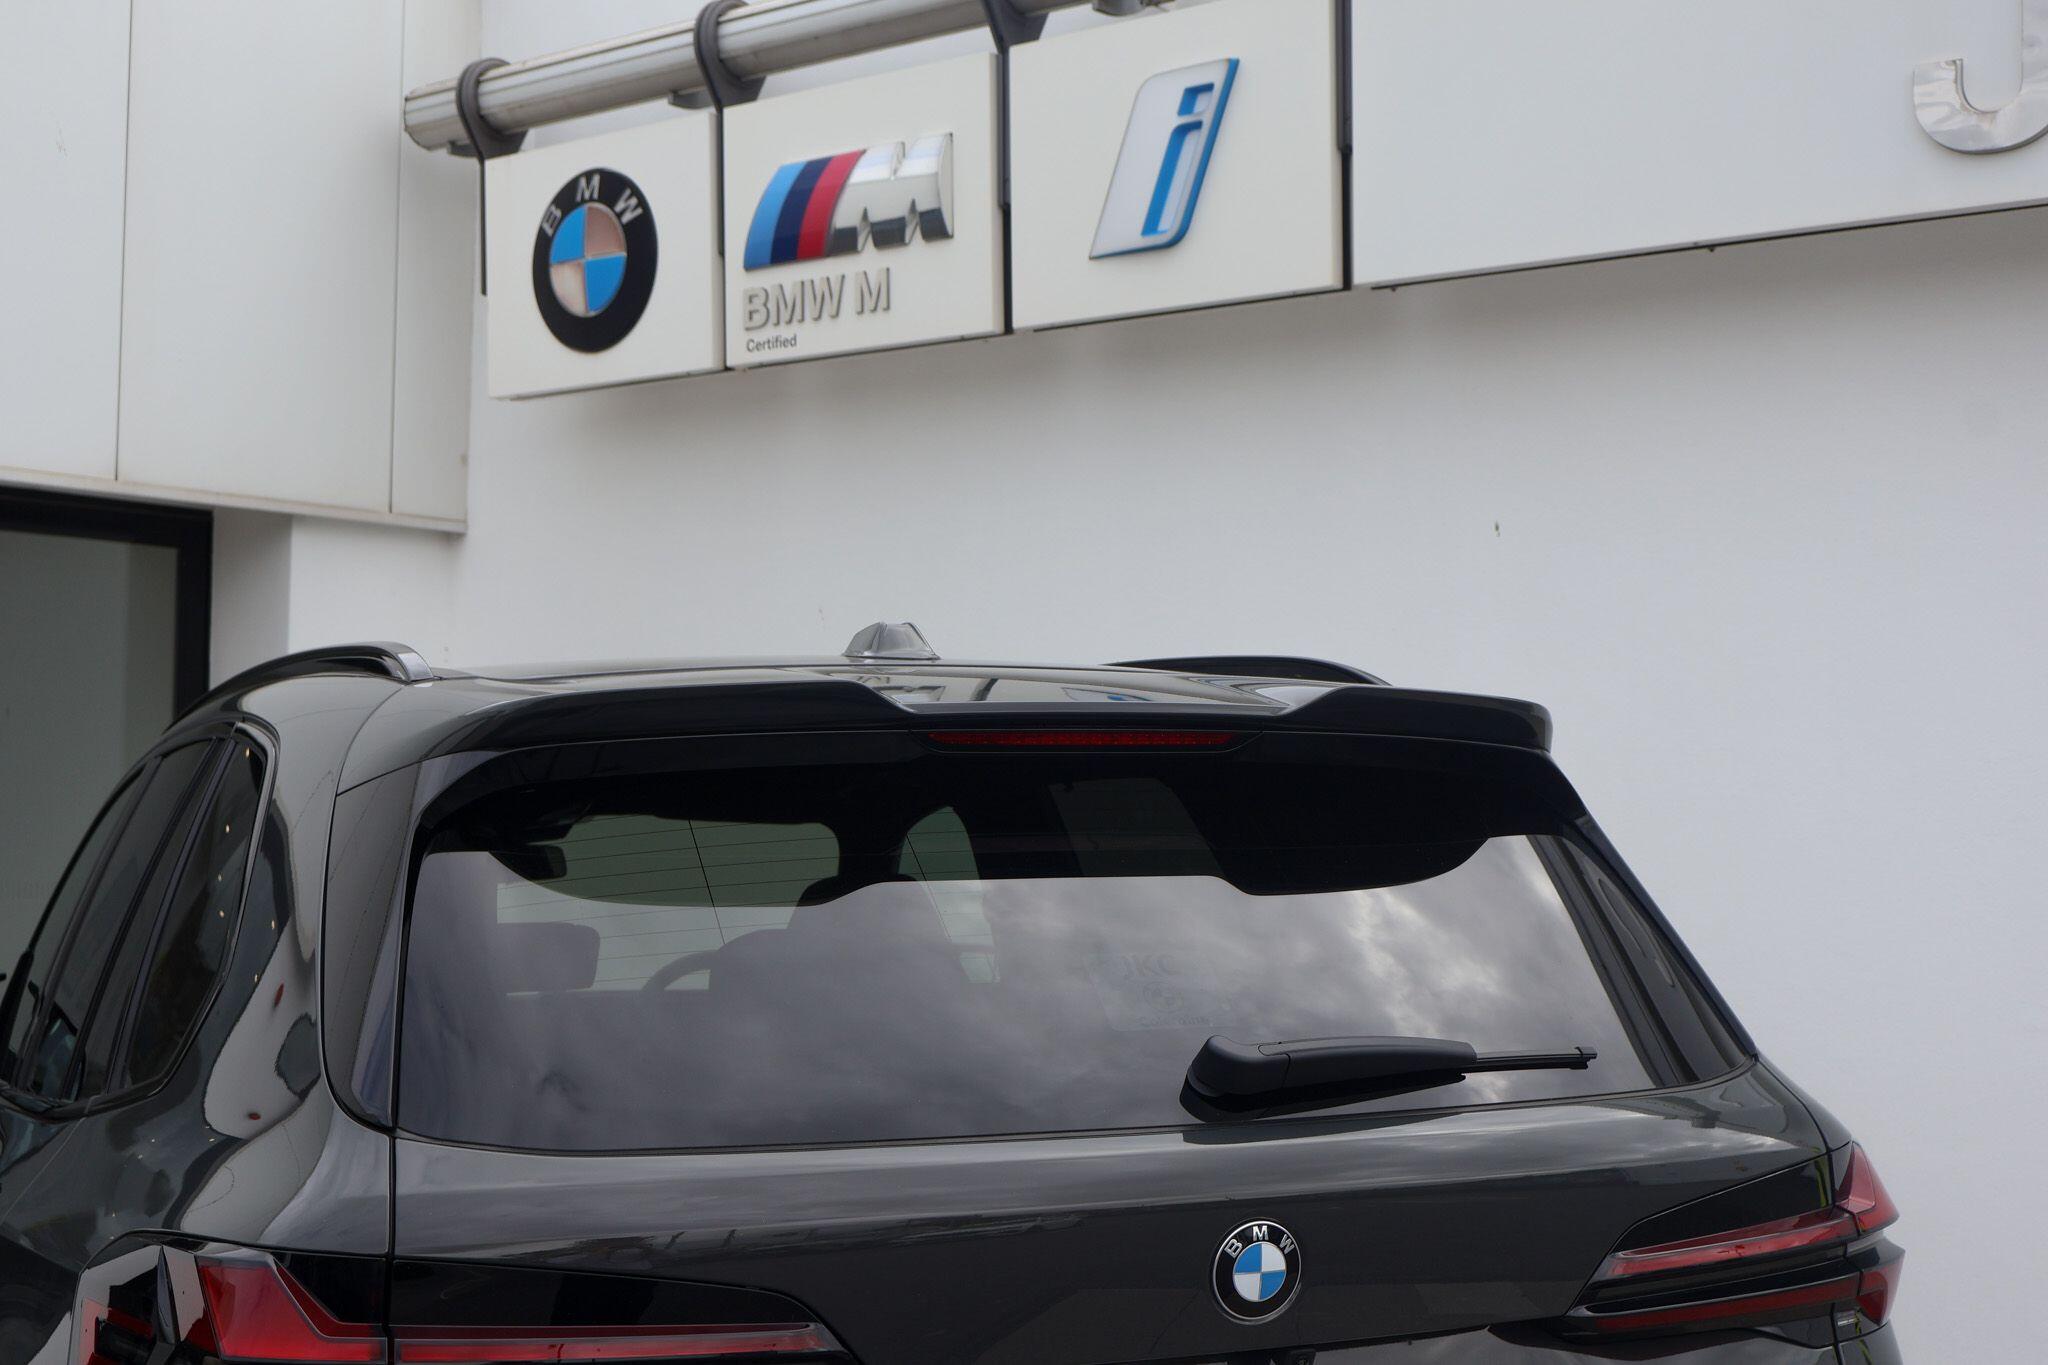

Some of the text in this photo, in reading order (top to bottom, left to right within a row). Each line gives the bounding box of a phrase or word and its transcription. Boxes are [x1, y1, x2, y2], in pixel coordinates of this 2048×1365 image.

[542, 174, 643, 236] BMW
[744, 267, 890, 330] BMW M
[746, 334, 797, 352] Certified
[1224, 1225, 1295, 1259] BMW
